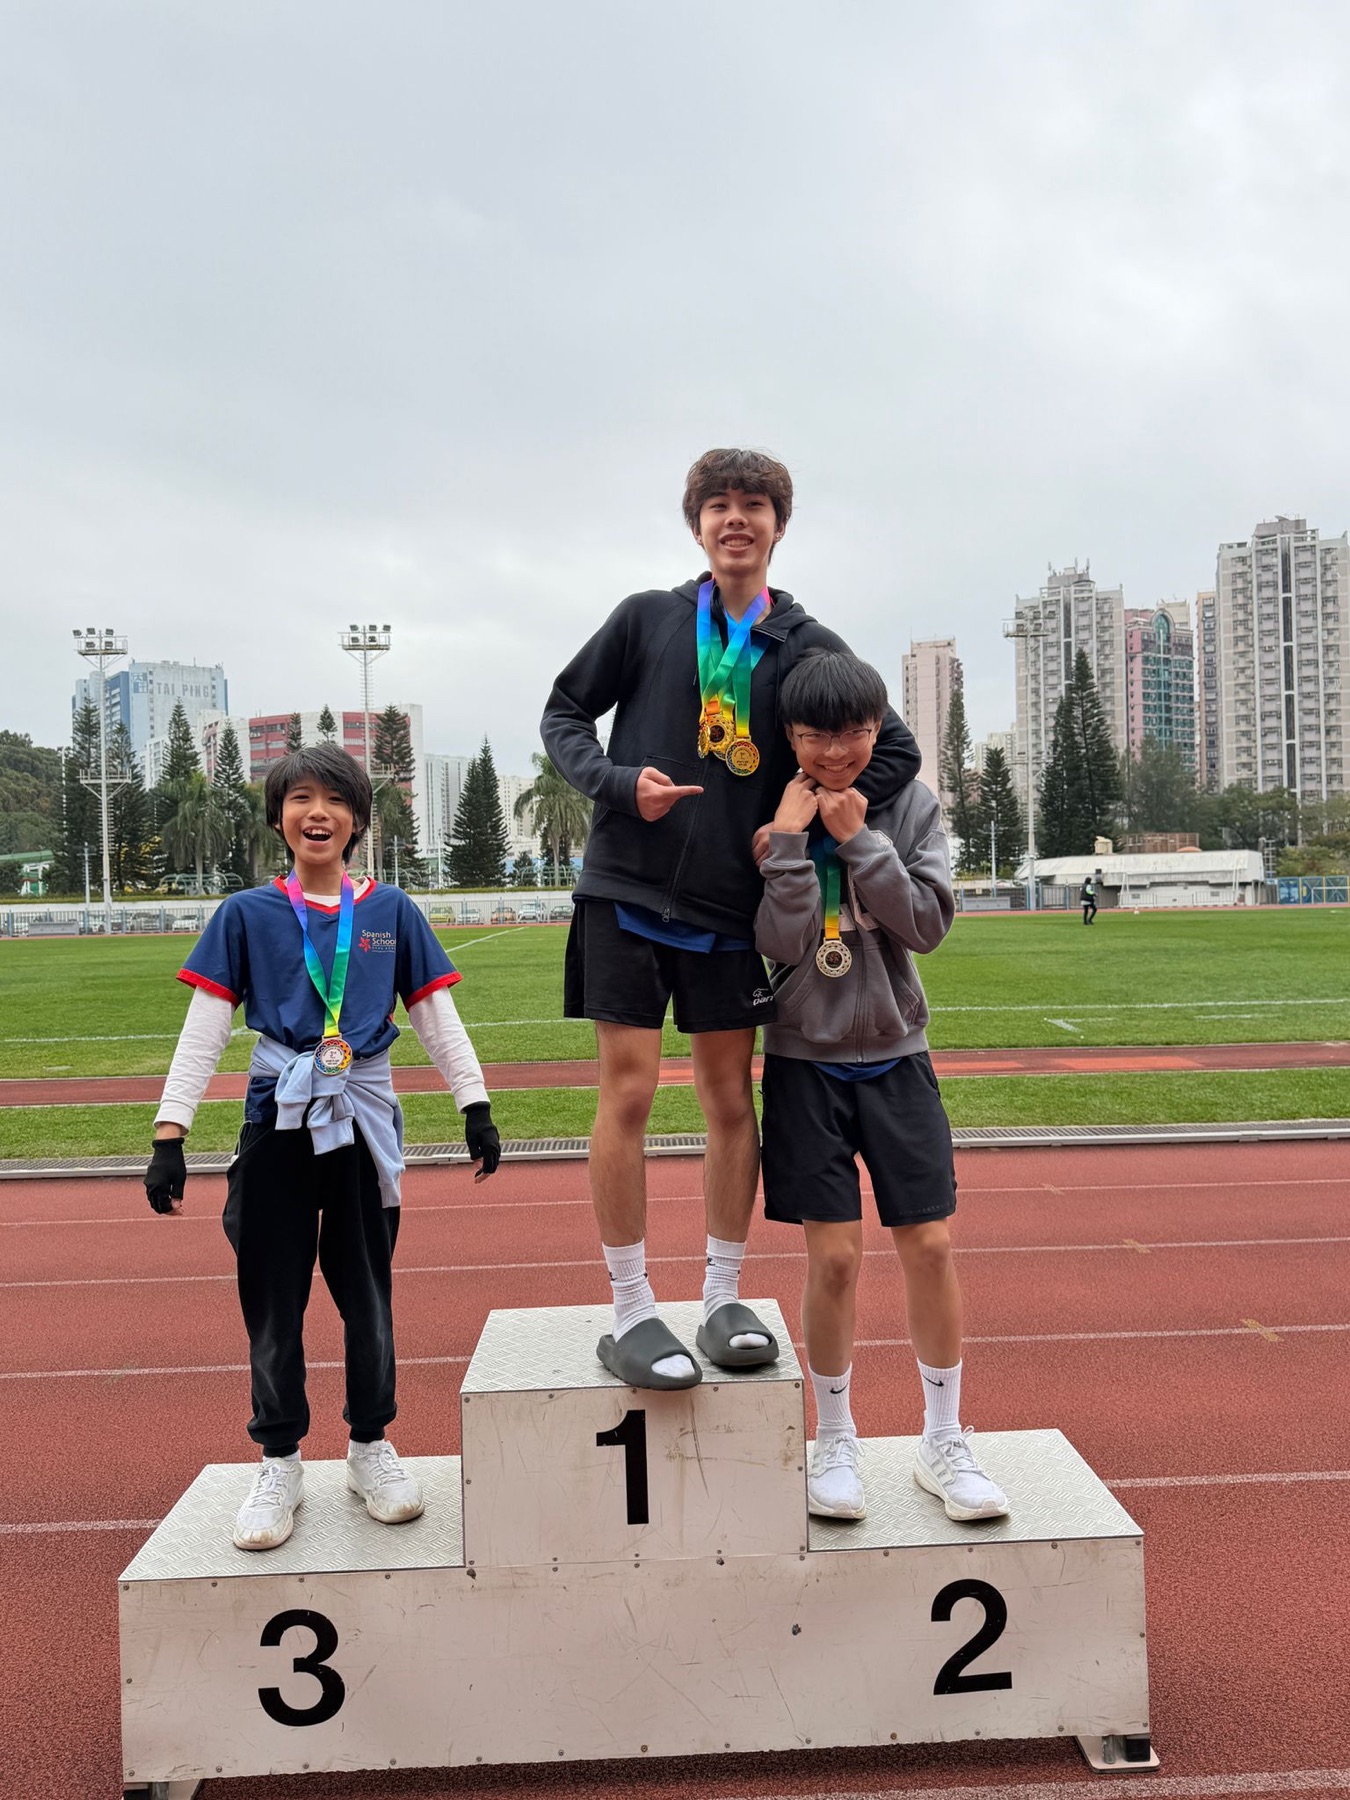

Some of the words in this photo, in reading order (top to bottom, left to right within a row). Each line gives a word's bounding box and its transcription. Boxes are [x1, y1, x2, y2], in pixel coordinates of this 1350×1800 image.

[156, 682, 175, 696] TAI
[182, 684, 209, 698] PING
[362, 929, 391, 939] Spanish
[372, 937, 396, 945] School
[596, 1409, 649, 1525] 1
[258, 1609, 345, 1726] 3
[931, 1579, 1012, 1695] 2
